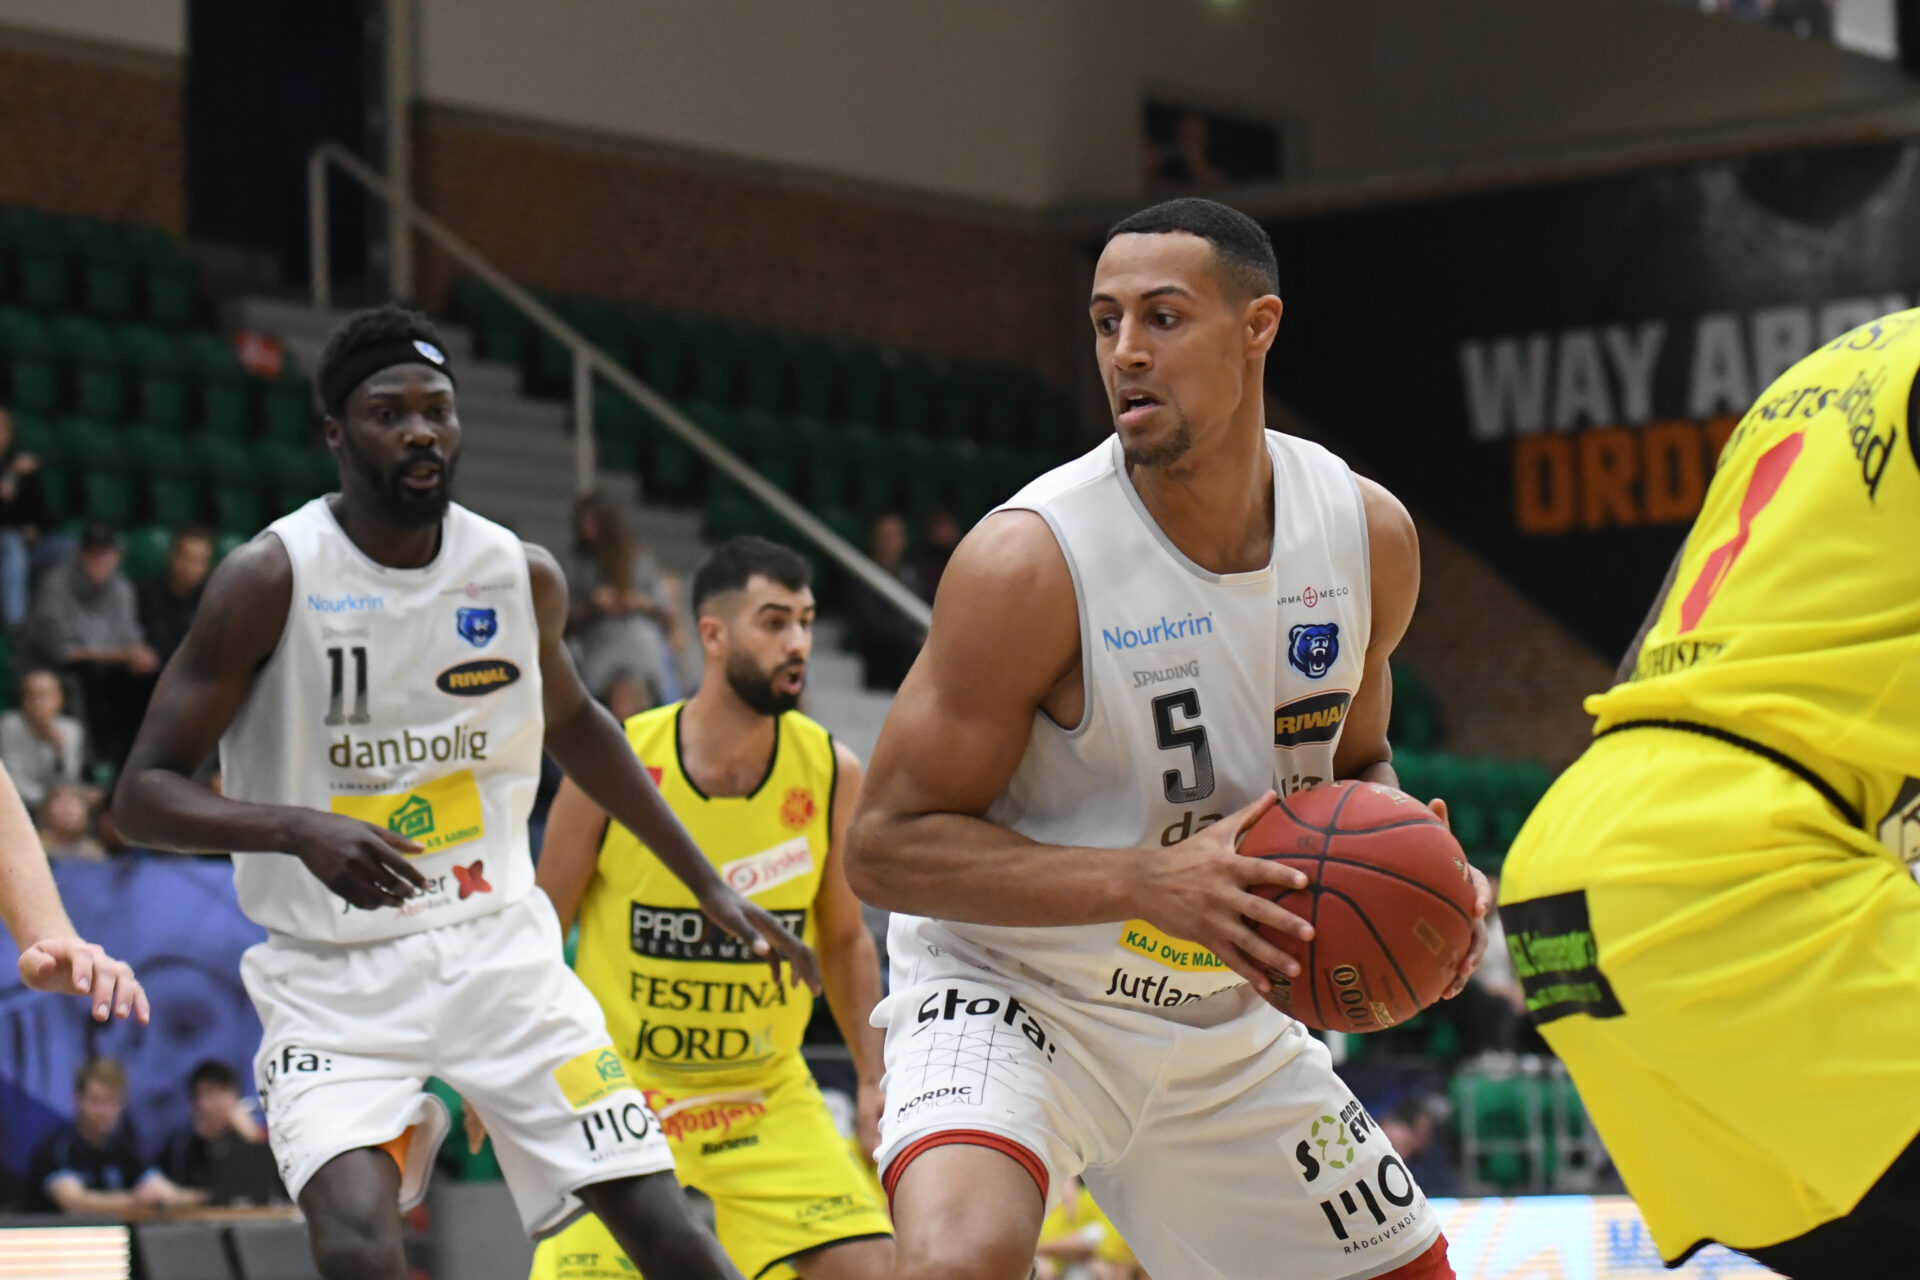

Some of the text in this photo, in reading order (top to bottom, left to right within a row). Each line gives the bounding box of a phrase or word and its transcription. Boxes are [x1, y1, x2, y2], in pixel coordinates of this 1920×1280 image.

[1461, 320, 1668, 441] WAY
[1515, 413, 1748, 535] ORD
[307, 594, 385, 613] Nourkrin
[1102, 612, 1212, 652] Nourkrin
[323, 646, 371, 727] 11
[448, 666, 510, 689] RIWAL
[1133, 660, 1200, 689] SPALDING
[328, 726, 488, 769] danbolig
[1151, 687, 1216, 804] 5
[1126, 931, 1228, 968] KAJ OVE MAD
[630, 971, 788, 1015] FESTINA
[897, 1086, 972, 1118] NORDIC
[1343, 1211, 1417, 1255] RÅDGIVENDE
